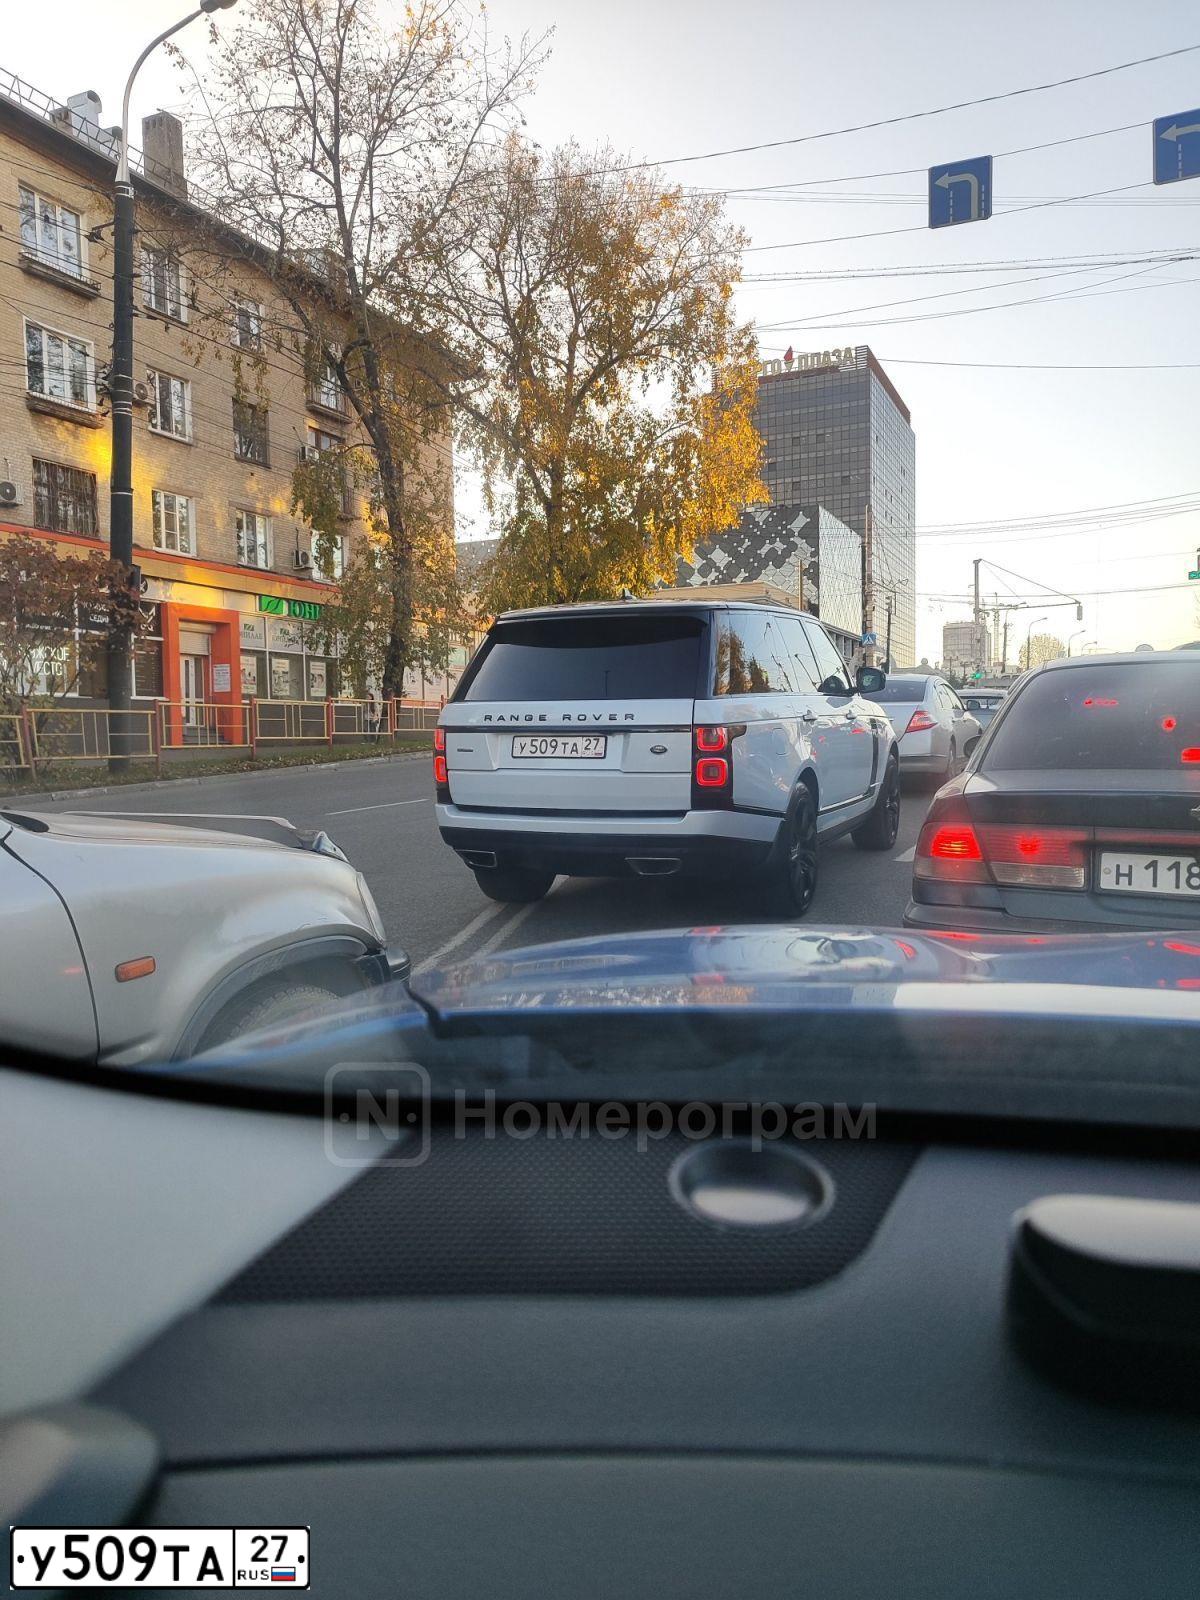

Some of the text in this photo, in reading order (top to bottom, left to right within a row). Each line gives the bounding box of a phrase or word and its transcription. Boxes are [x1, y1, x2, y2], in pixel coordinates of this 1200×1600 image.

[483, 712, 636, 722] RANGE ROVER
[584, 738, 601, 751] 27
